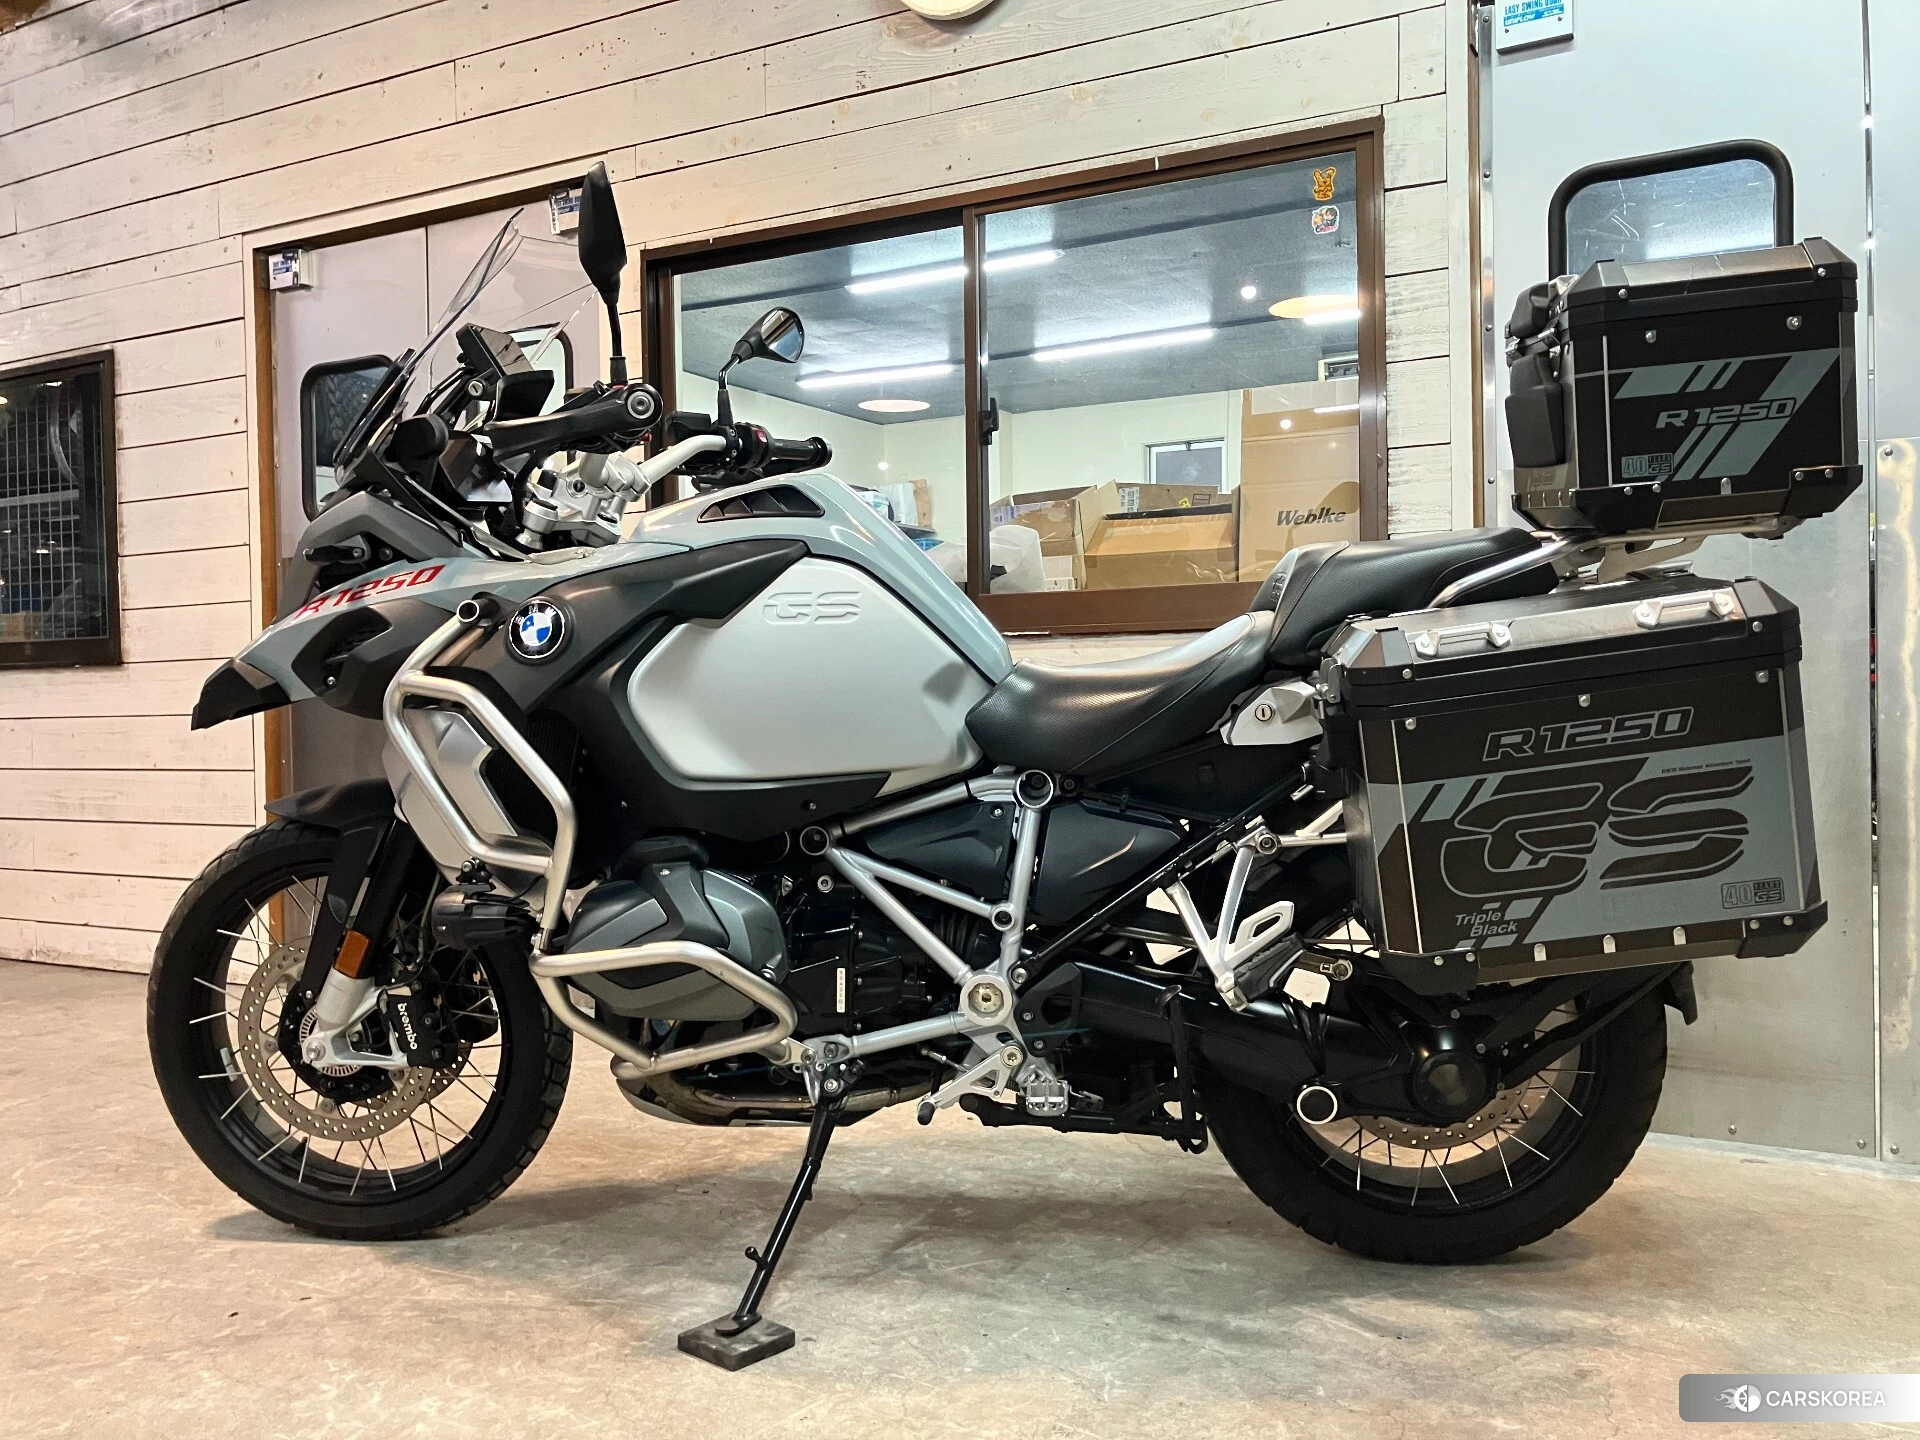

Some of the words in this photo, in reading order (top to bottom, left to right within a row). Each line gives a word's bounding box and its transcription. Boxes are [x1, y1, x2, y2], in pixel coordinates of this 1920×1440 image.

[1505, 4, 1520, 15] EASY
[1624, 457, 1647, 476] 40
[1649, 463, 1672, 474] GS
[763, 591, 862, 625] GS
[1441, 766, 1754, 900] GS
[1725, 884, 1753, 906] 40
[1755, 889, 1782, 903] GS
[1455, 910, 1502, 927] Triple
[1470, 920, 1518, 937] Black
[397, 1002, 418, 1050] brembo
